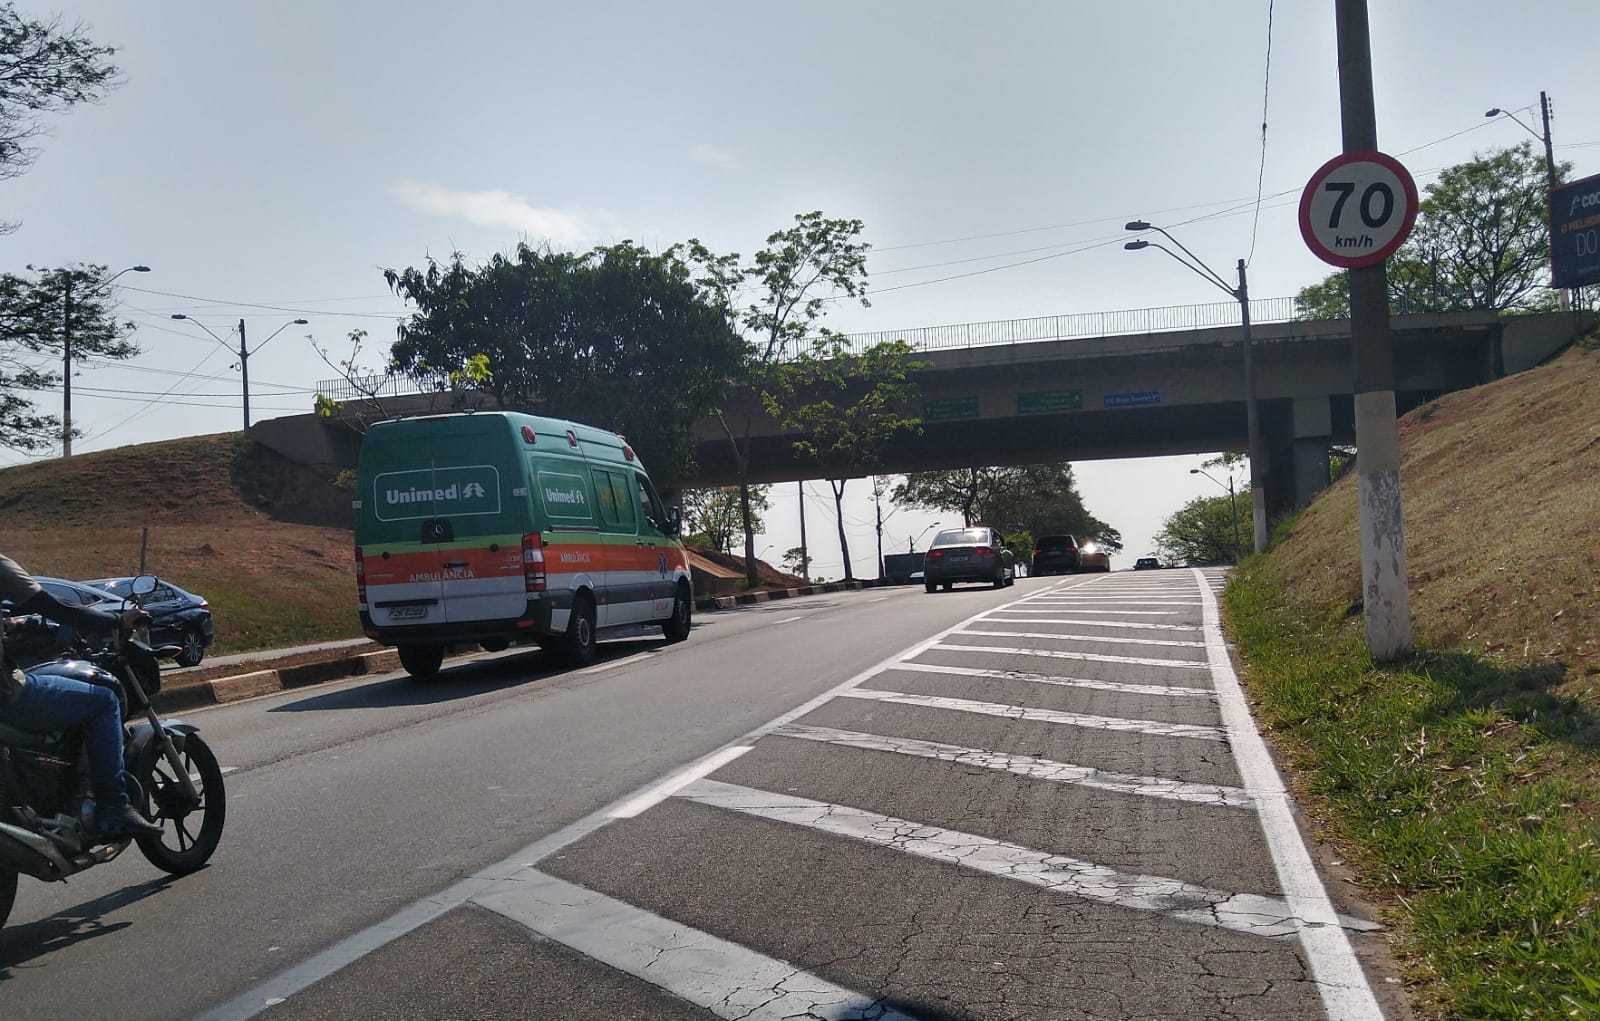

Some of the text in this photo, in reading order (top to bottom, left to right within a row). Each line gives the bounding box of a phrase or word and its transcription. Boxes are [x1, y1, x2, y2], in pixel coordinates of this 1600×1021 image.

[1325, 182, 1394, 228] 70
[1335, 235, 1373, 248] km/h
[386, 484, 458, 504] Unimed
[545, 487, 576, 504] Unimed
